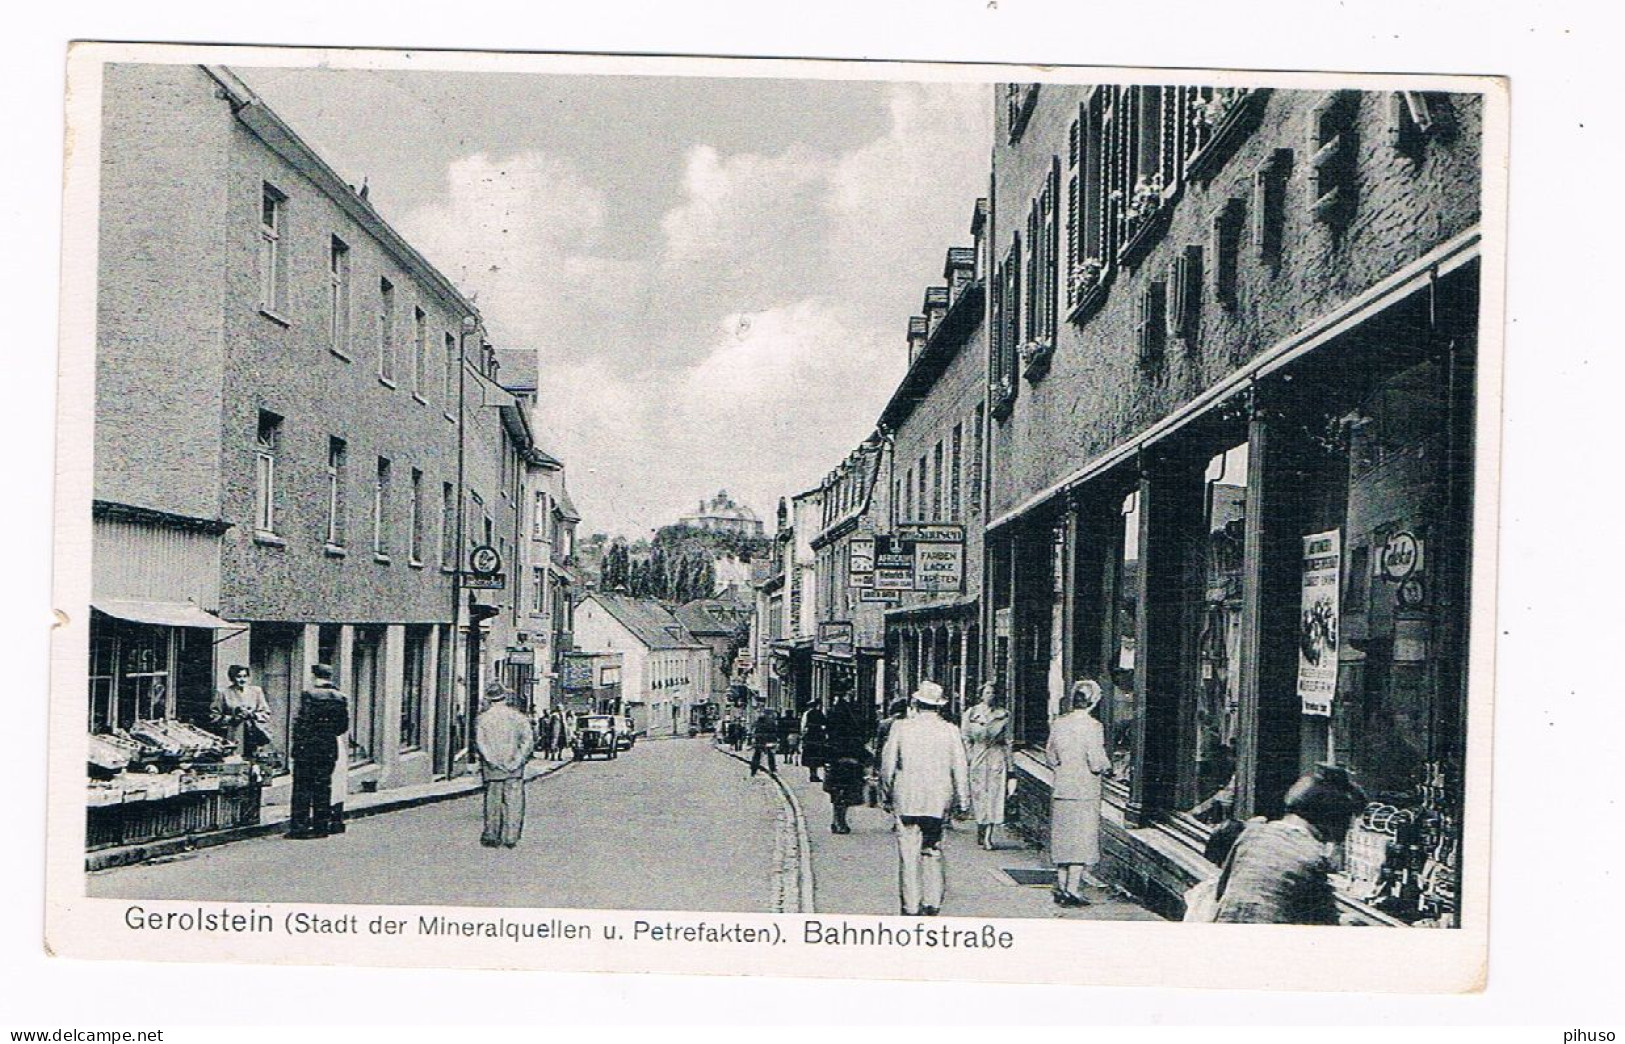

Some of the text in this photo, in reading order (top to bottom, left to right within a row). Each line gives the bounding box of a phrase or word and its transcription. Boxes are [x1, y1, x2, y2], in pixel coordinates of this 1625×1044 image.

[920, 551, 956, 561] FARBEN
[923, 563, 954, 572] LACKE
[918, 574, 958, 584] TAPETEN
